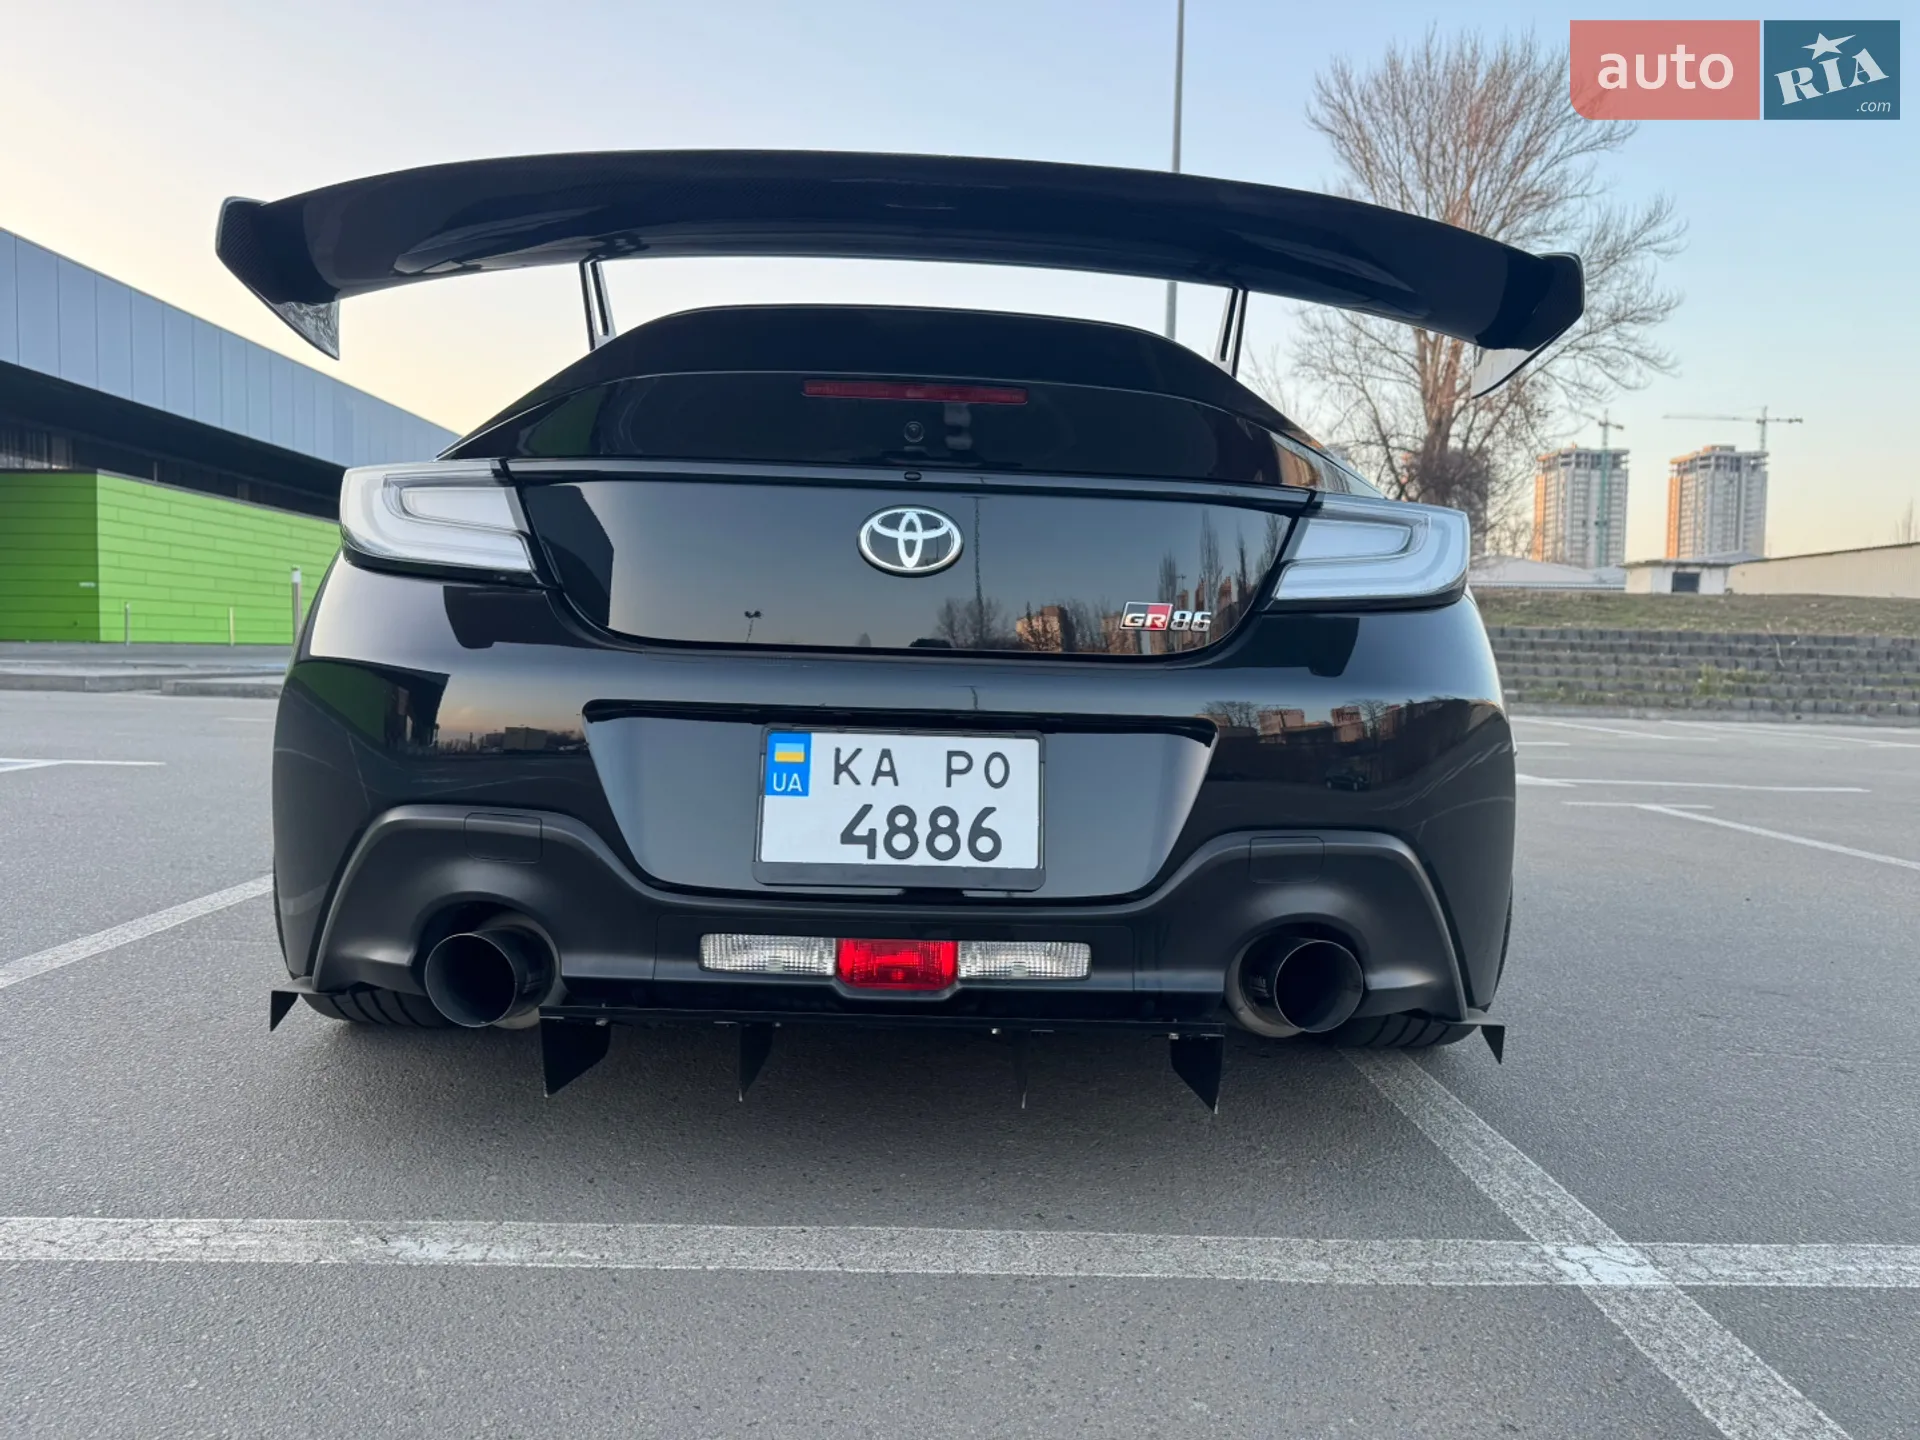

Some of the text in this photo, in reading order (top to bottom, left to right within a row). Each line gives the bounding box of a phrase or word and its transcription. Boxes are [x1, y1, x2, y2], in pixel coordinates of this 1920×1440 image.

[772, 772, 803, 792] UA
[833, 747, 899, 787] KA
[839, 803, 1003, 862] 4886
